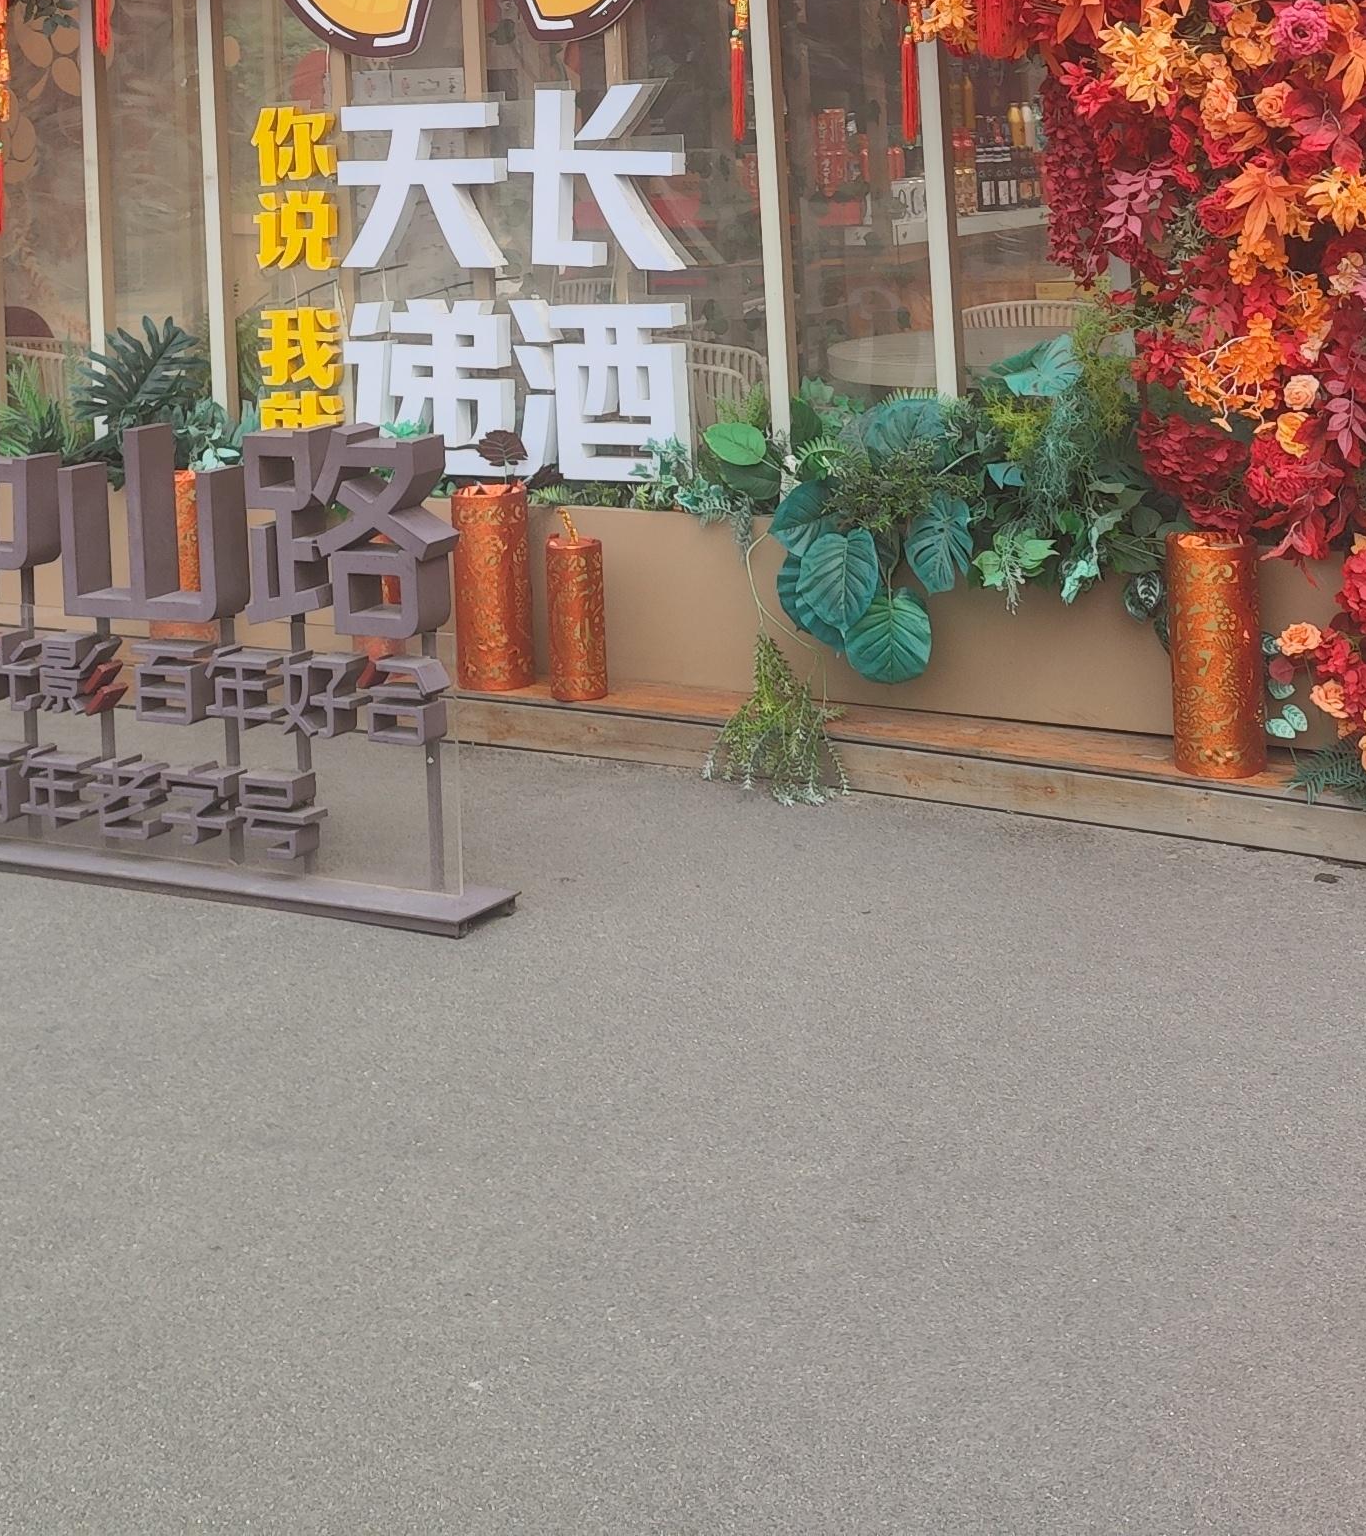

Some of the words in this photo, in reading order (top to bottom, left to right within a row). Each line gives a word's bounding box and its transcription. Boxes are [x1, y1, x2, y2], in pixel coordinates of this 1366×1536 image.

[251, 105, 338, 271] 你说
[337, 83, 688, 271] 天长
[343, 299, 690, 481] 递酒
[131, 639, 452, 746] 百年好合
